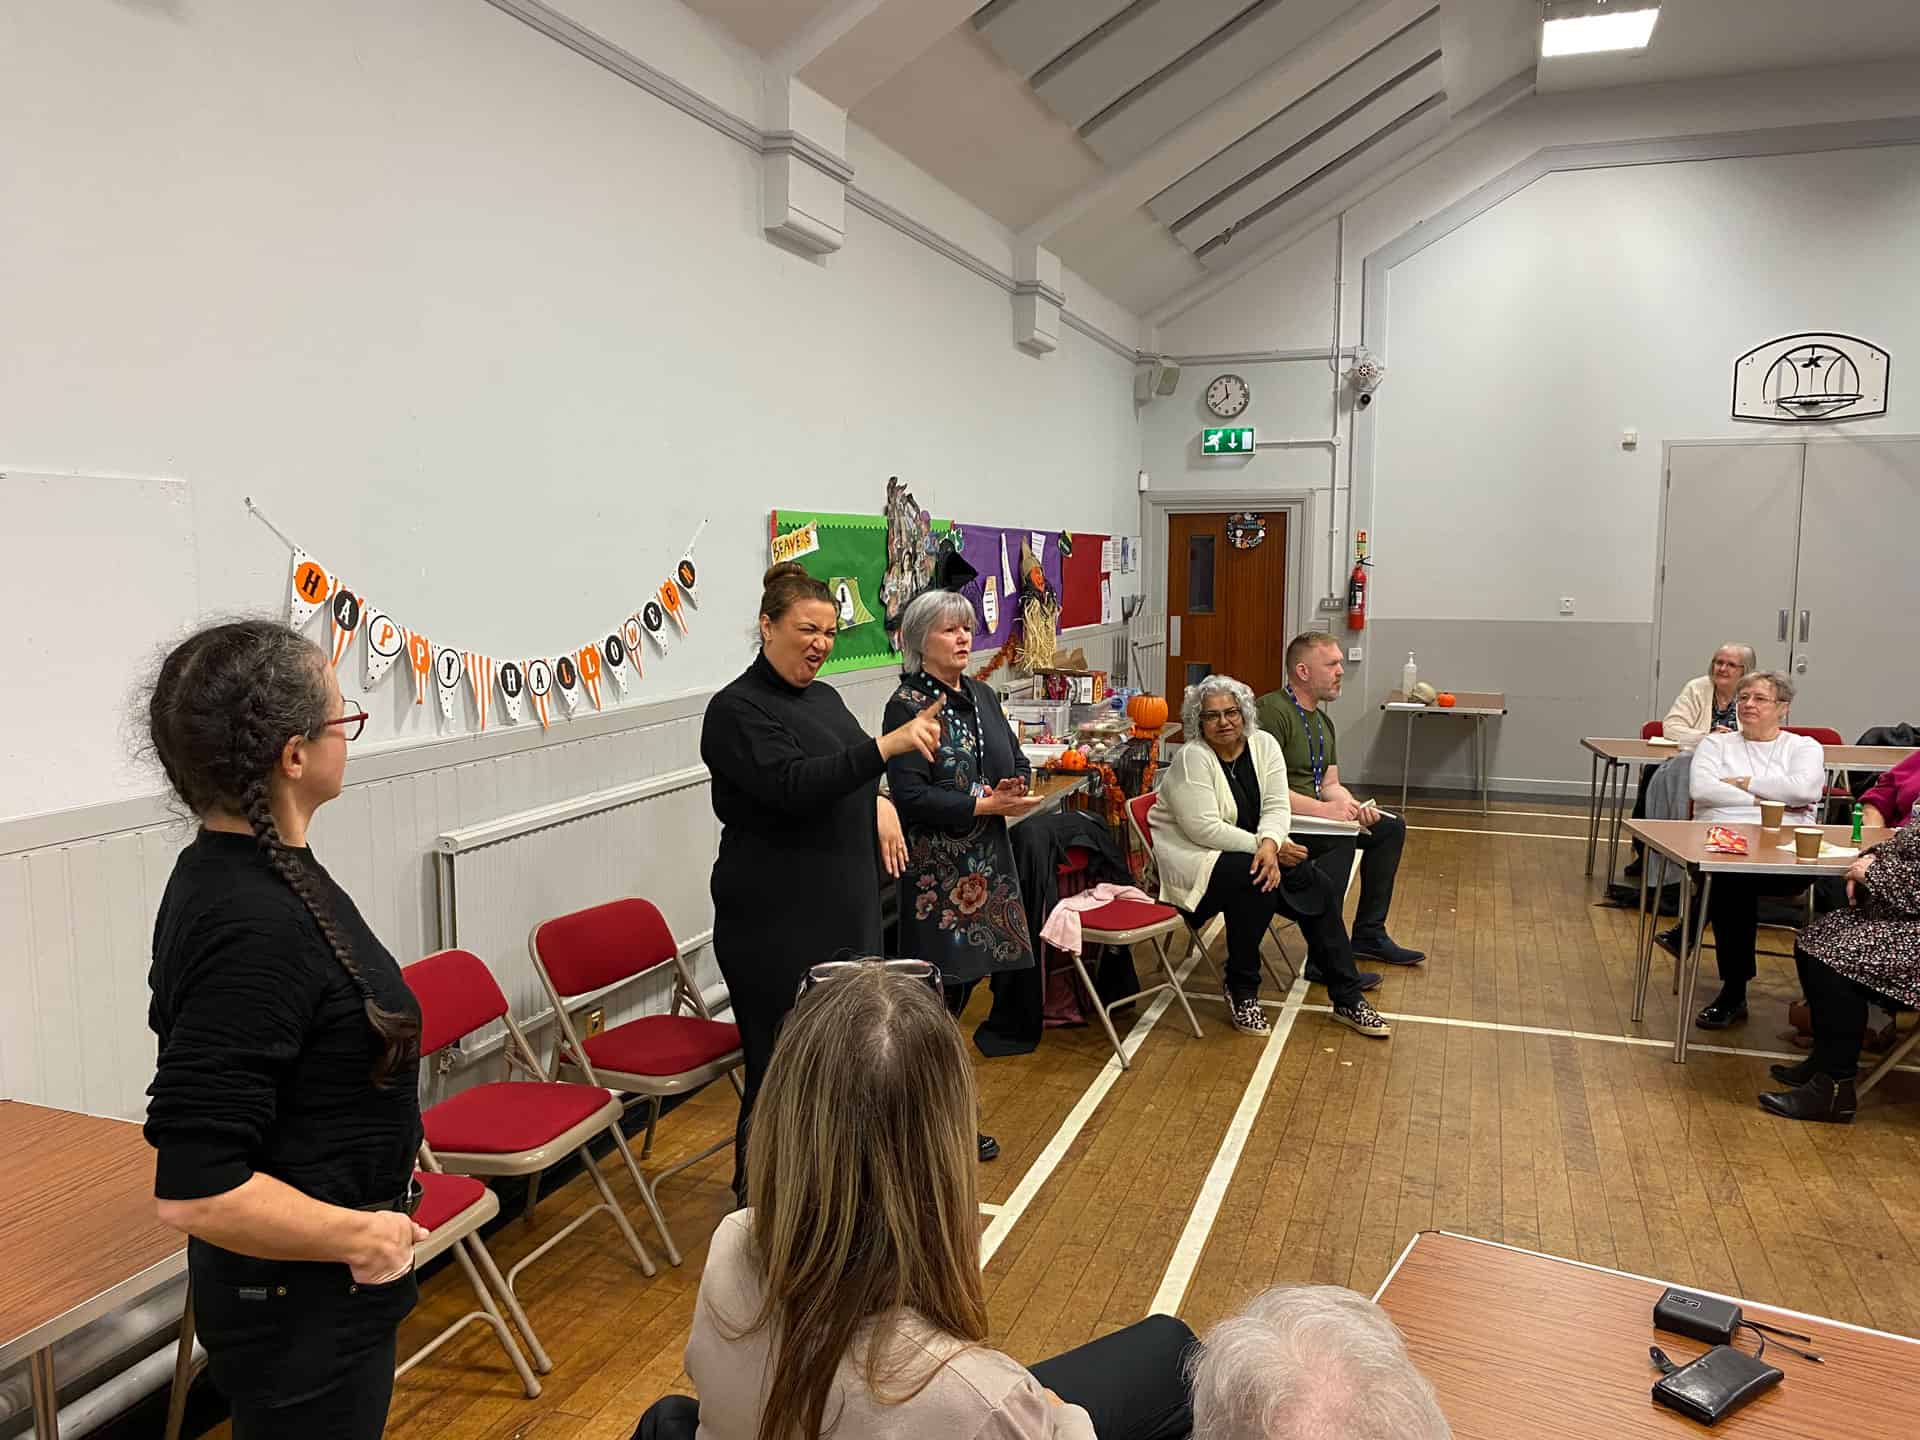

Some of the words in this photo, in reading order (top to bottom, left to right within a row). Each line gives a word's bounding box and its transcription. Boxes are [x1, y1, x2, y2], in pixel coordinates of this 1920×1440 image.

[773, 529, 811, 561] BEAVERS
[302, 568, 455, 680] HAPPY
[505, 564, 694, 692] HALLOWEEN
